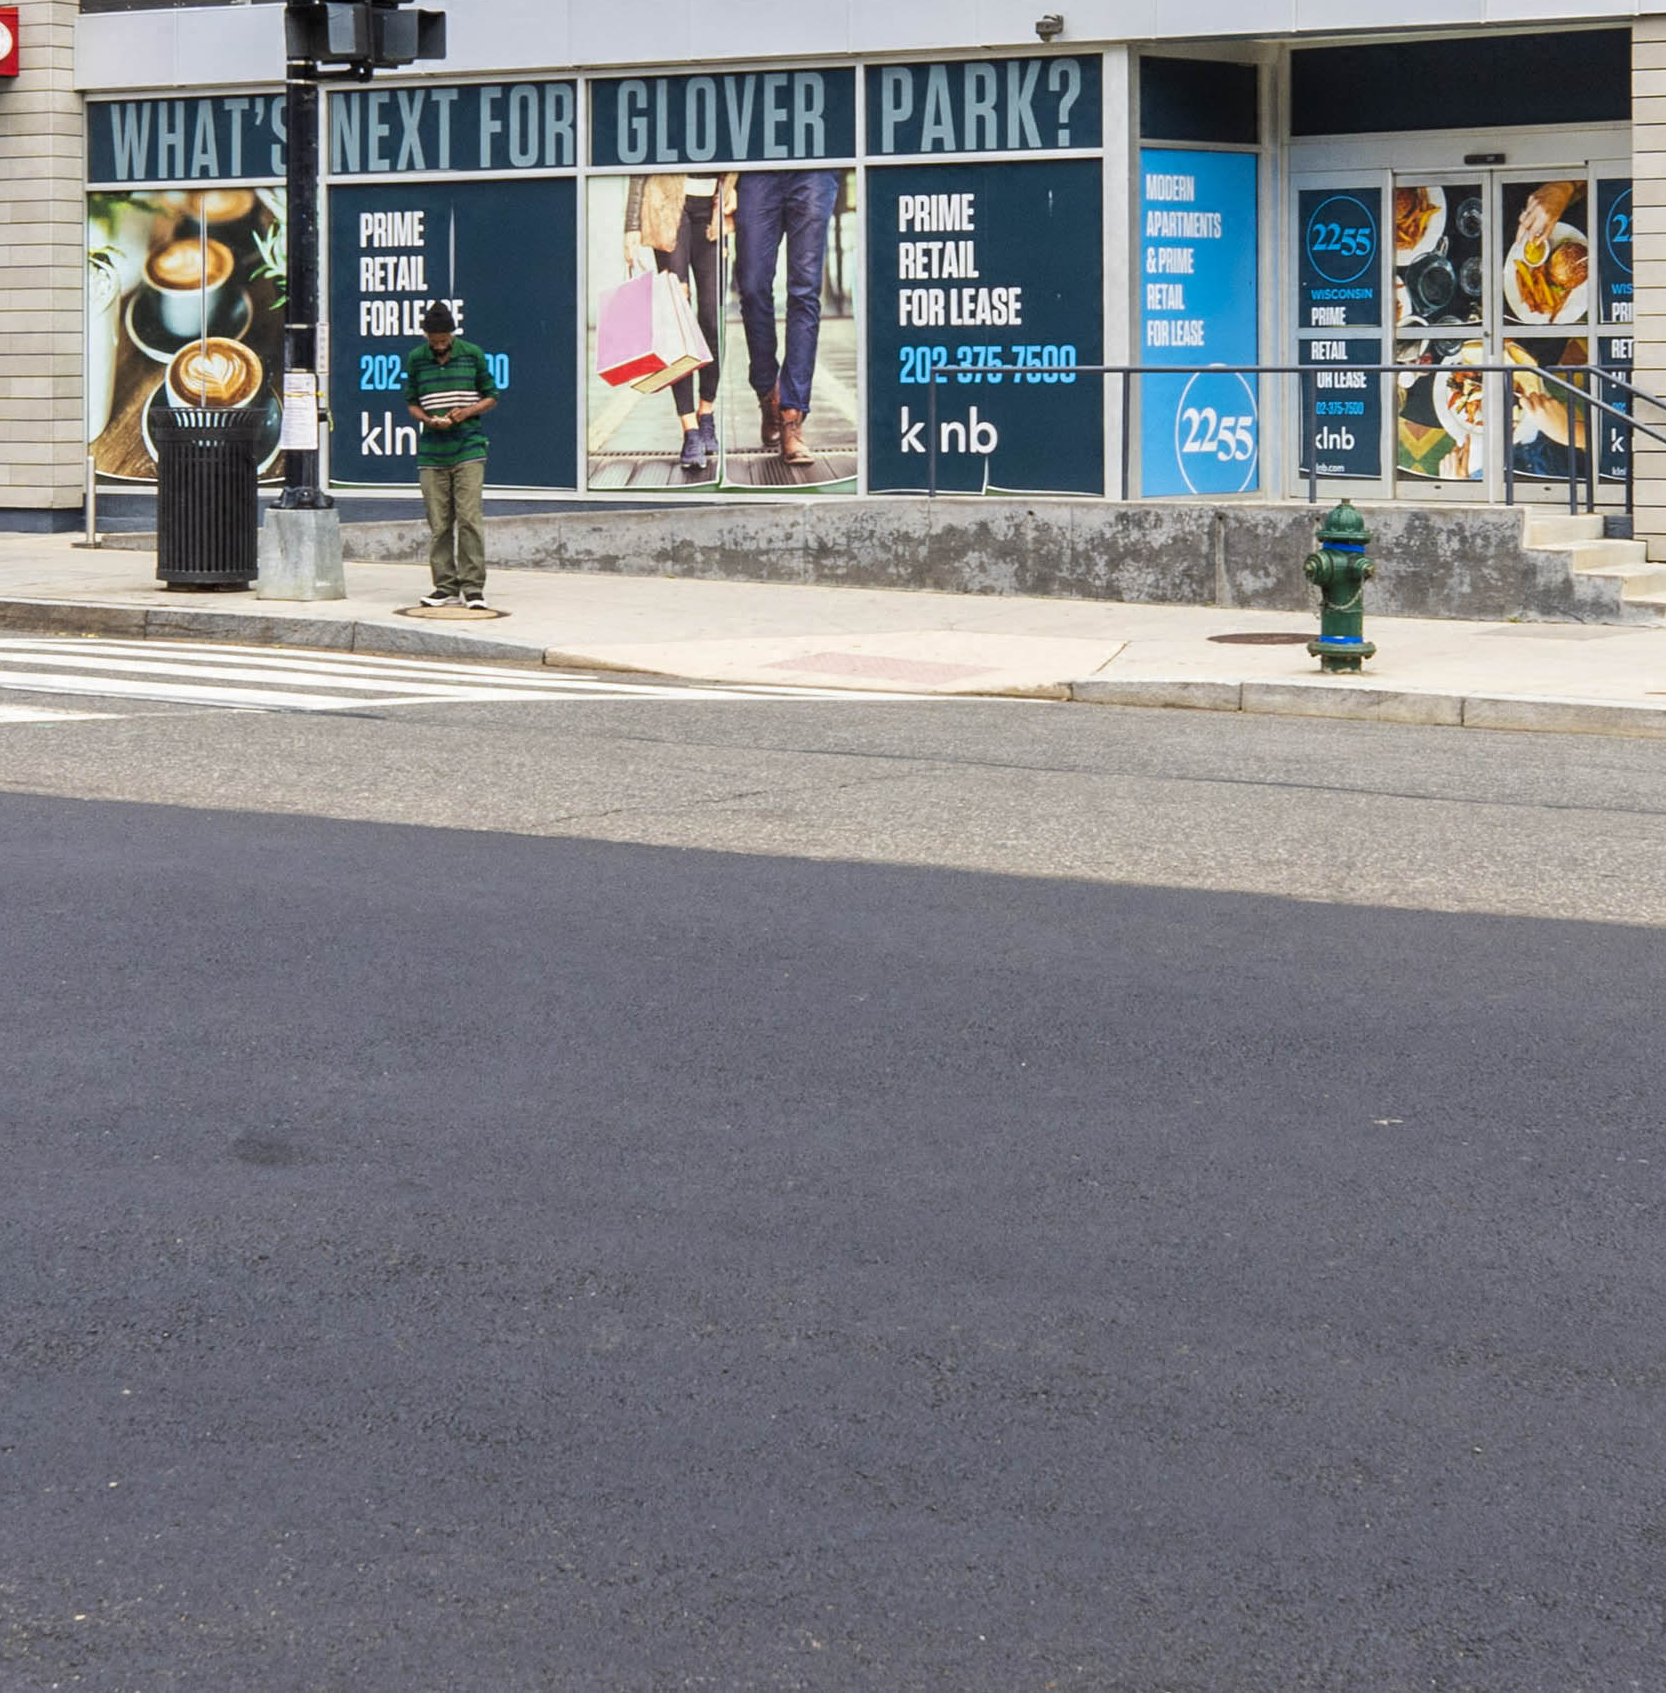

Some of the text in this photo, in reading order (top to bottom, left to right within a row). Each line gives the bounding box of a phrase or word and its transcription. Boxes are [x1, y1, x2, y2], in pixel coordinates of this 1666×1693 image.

[332, 88, 459, 173] NEXT
[479, 83, 574, 169] FOR
[617, 72, 826, 164] GLOVER
[881, 58, 1081, 154] PARK?
[1145, 174, 1195, 202] MODERN
[359, 211, 424, 248] PRIME
[899, 194, 975, 232] PRIME
[1145, 211, 1222, 239] APARTMENTS
[1312, 223, 1372, 256] 2255
[359, 256, 428, 292] RETAIL
[899, 241, 979, 279] RETAIL
[1146, 247, 1195, 275] & PRIME
[899, 287, 1022, 326] FOR LEASE
[1146, 283, 1185, 310] RETAIL
[1311, 288, 1373, 300] WISCONSIN
[359, 299, 464, 336] FOR LEE
[1146, 320, 1205, 347] FOR LEASE
[1311, 307, 1346, 326] PRIME
[1311, 341, 1348, 360] RETAIL
[361, 411, 424, 456] kln
[901, 406, 998, 453] knb
[1181, 407, 1253, 462] 2255
